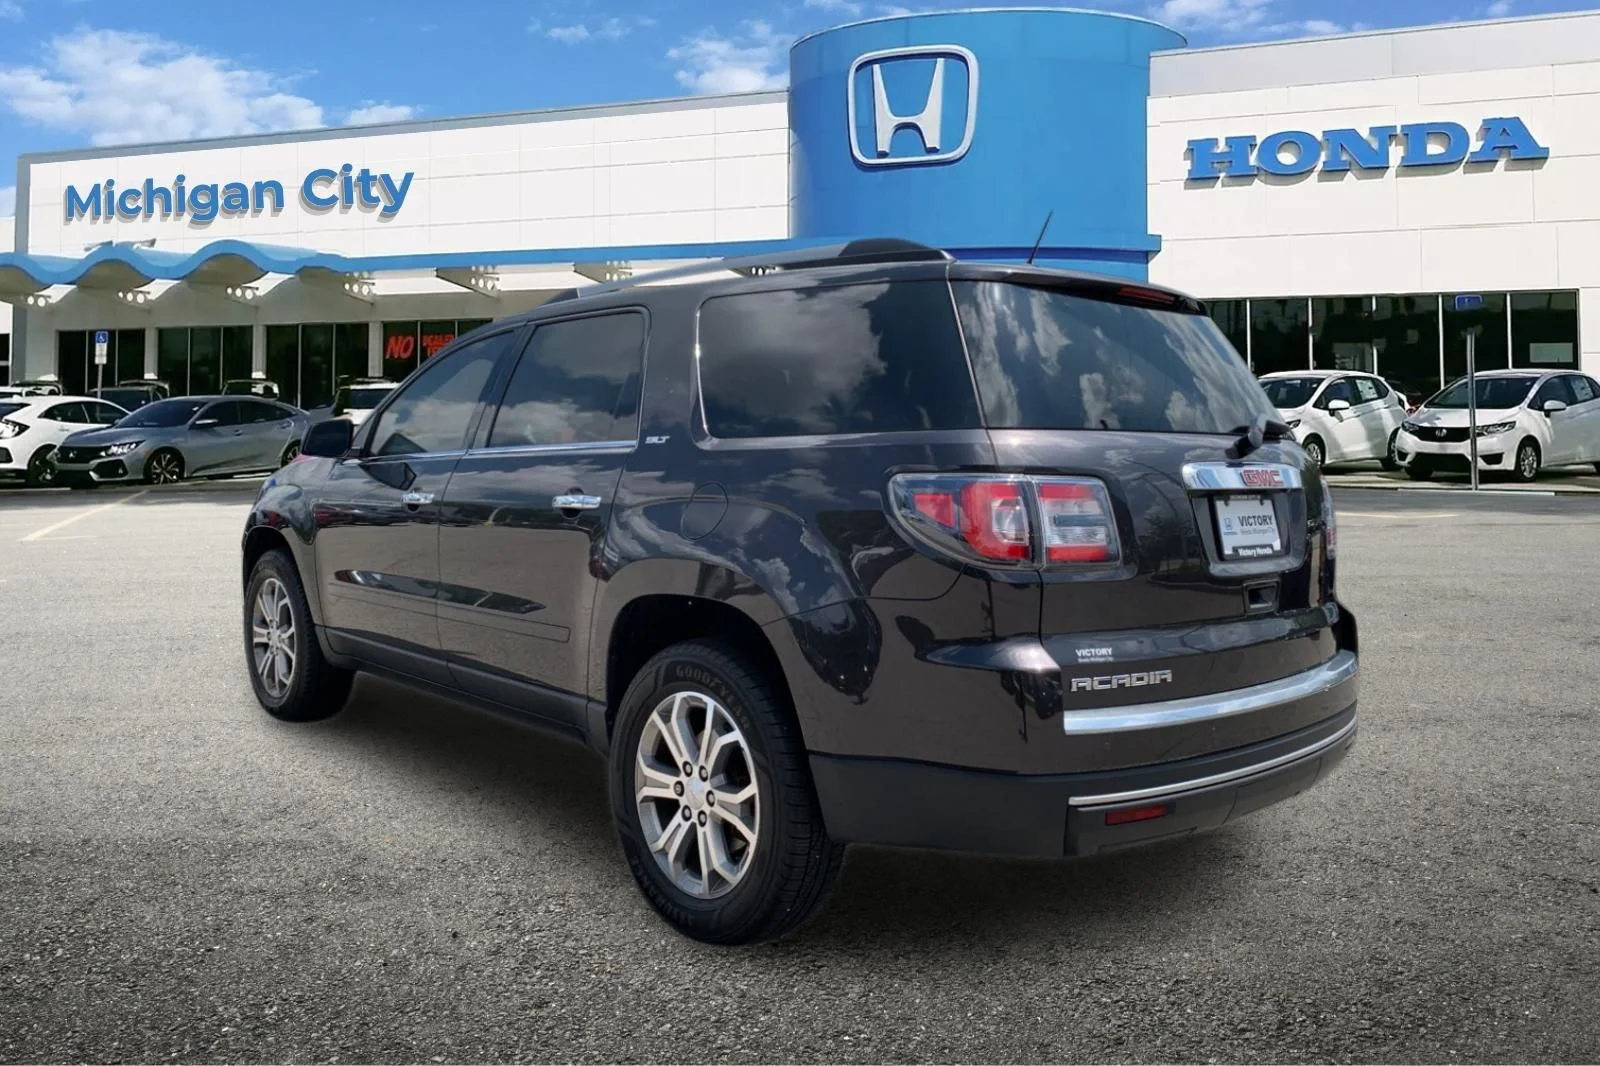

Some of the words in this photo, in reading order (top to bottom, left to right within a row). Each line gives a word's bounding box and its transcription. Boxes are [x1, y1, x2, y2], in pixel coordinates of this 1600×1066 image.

[1185, 116, 1550, 184] HONDA
[65, 172, 284, 222] Michigan
[302, 163, 415, 215] City
[385, 335, 415, 359] NO
[1242, 469, 1284, 486] GMC
[1237, 514, 1274, 527] VICTORY
[1075, 647, 1113, 657] VICTORY
[1070, 669, 1173, 692] ACADIA
